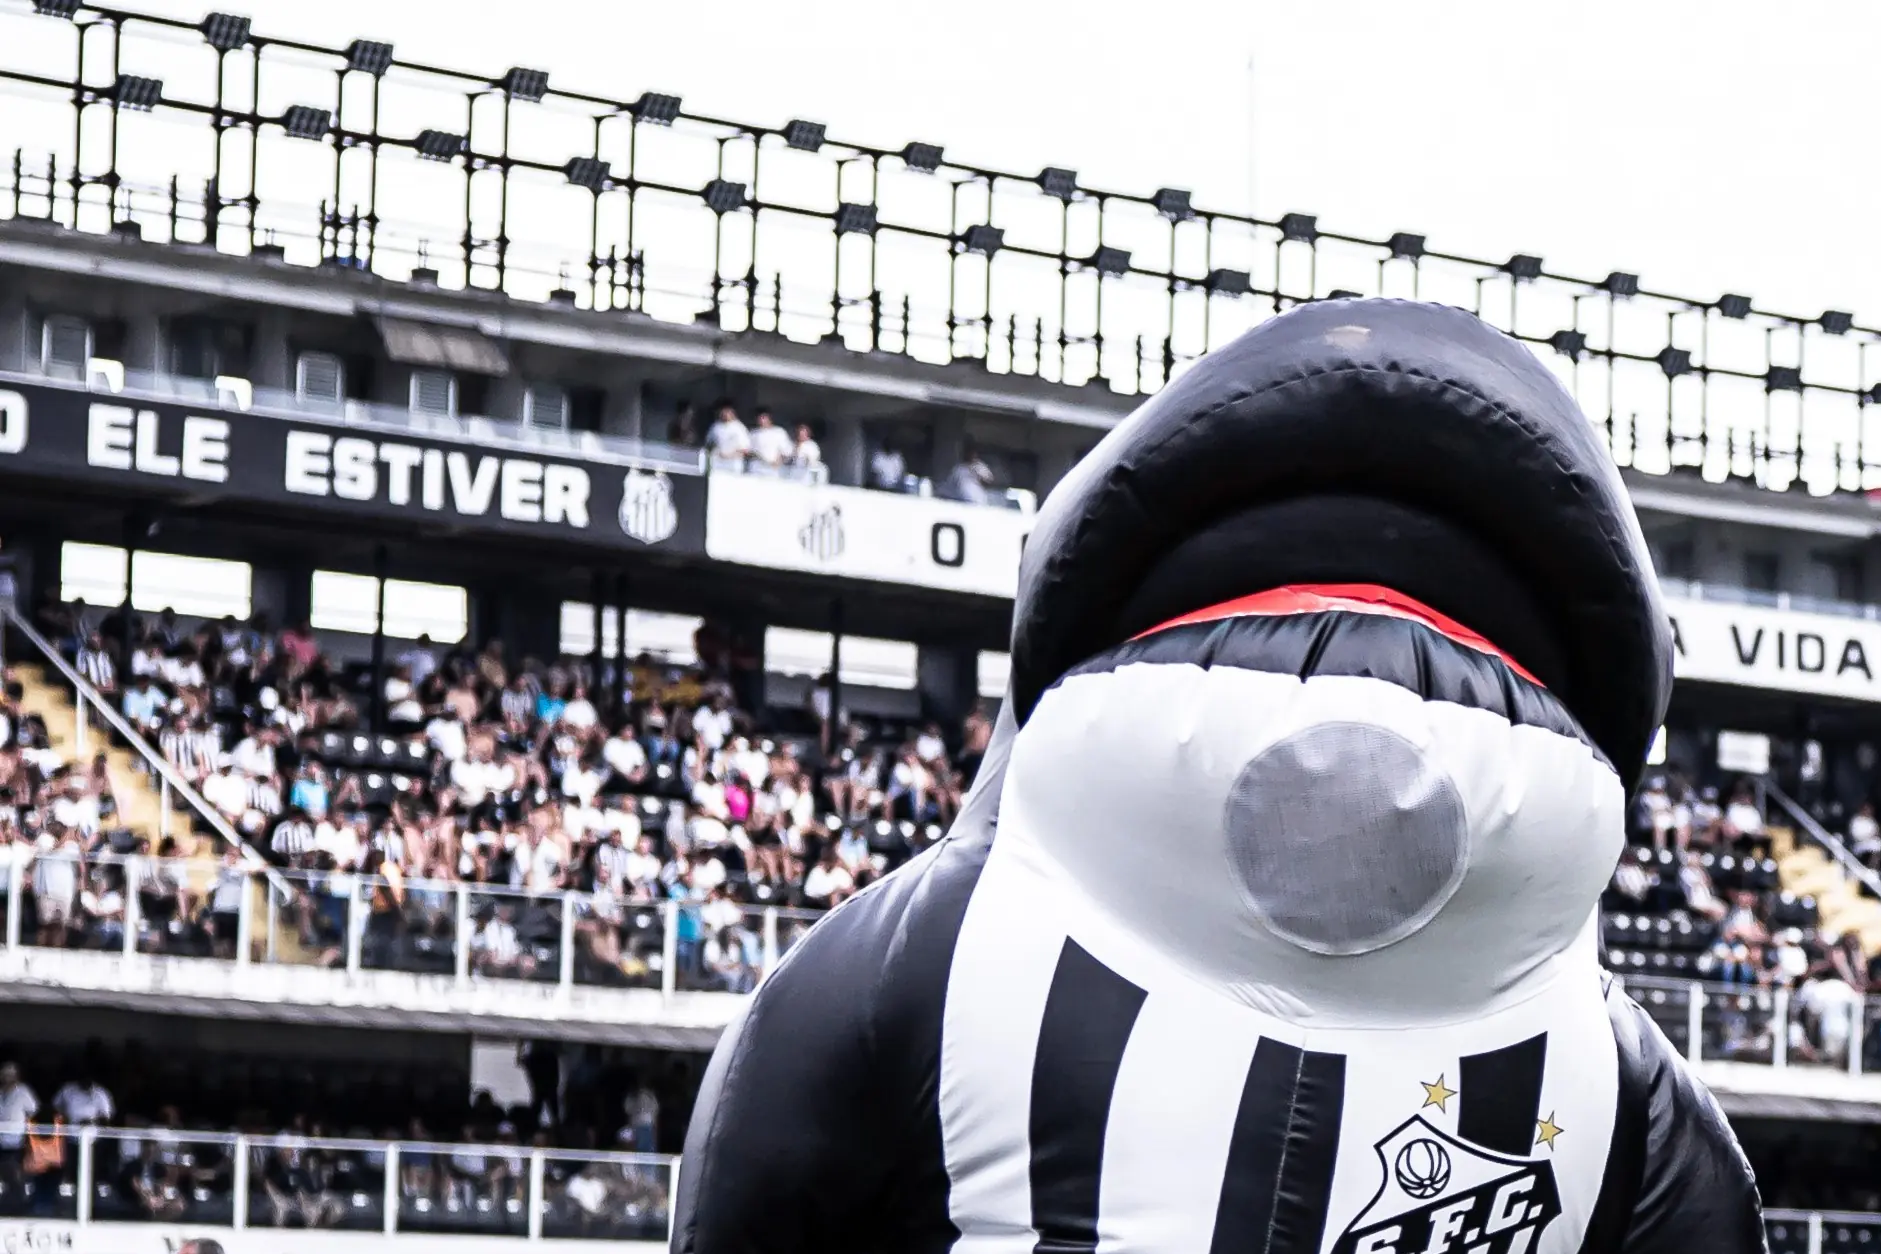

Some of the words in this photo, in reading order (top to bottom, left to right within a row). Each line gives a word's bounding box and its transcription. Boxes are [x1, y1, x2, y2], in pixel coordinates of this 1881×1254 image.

[87, 402, 231, 483] ELE
[285, 429, 591, 528] ESTIVER
[1730, 623, 1873, 681] VIDA
